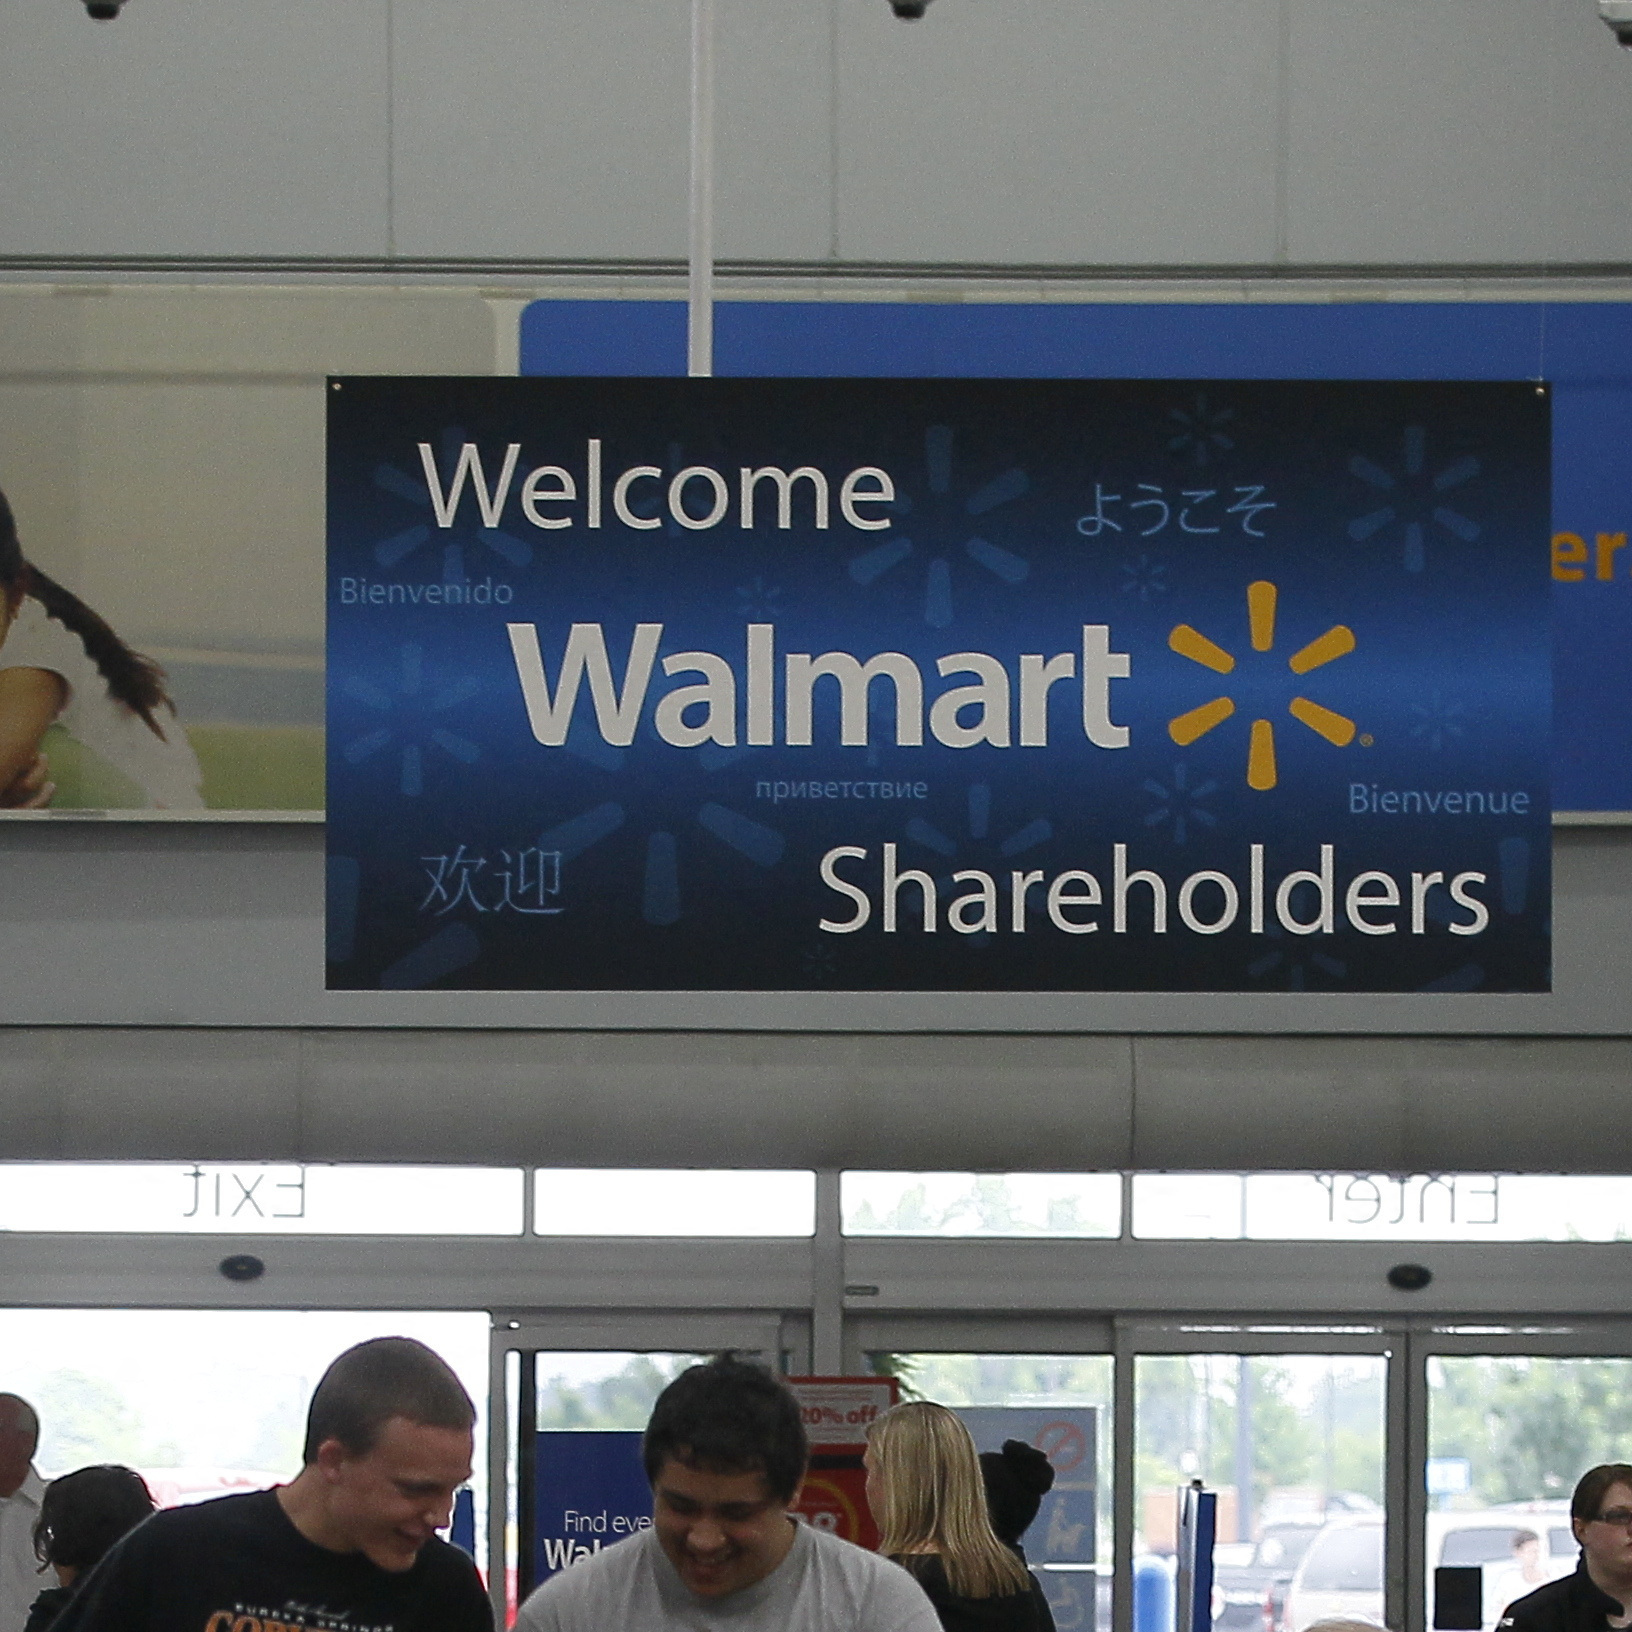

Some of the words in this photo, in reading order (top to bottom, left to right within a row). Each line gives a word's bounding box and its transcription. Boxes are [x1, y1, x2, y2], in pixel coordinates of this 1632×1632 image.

[416, 438, 896, 531] Welcome
[1075, 483, 1279, 538] ようこそ
[338, 576, 515, 605] Bienvenido
[504, 622, 1131, 750] Walmart
[754, 778, 930, 803] приветствие
[1348, 782, 1531, 816] Bienvenue
[417, 843, 567, 918] 欢迎
[817, 841, 1490, 937] Shareholders
[564, 1510, 607, 1533] Find
